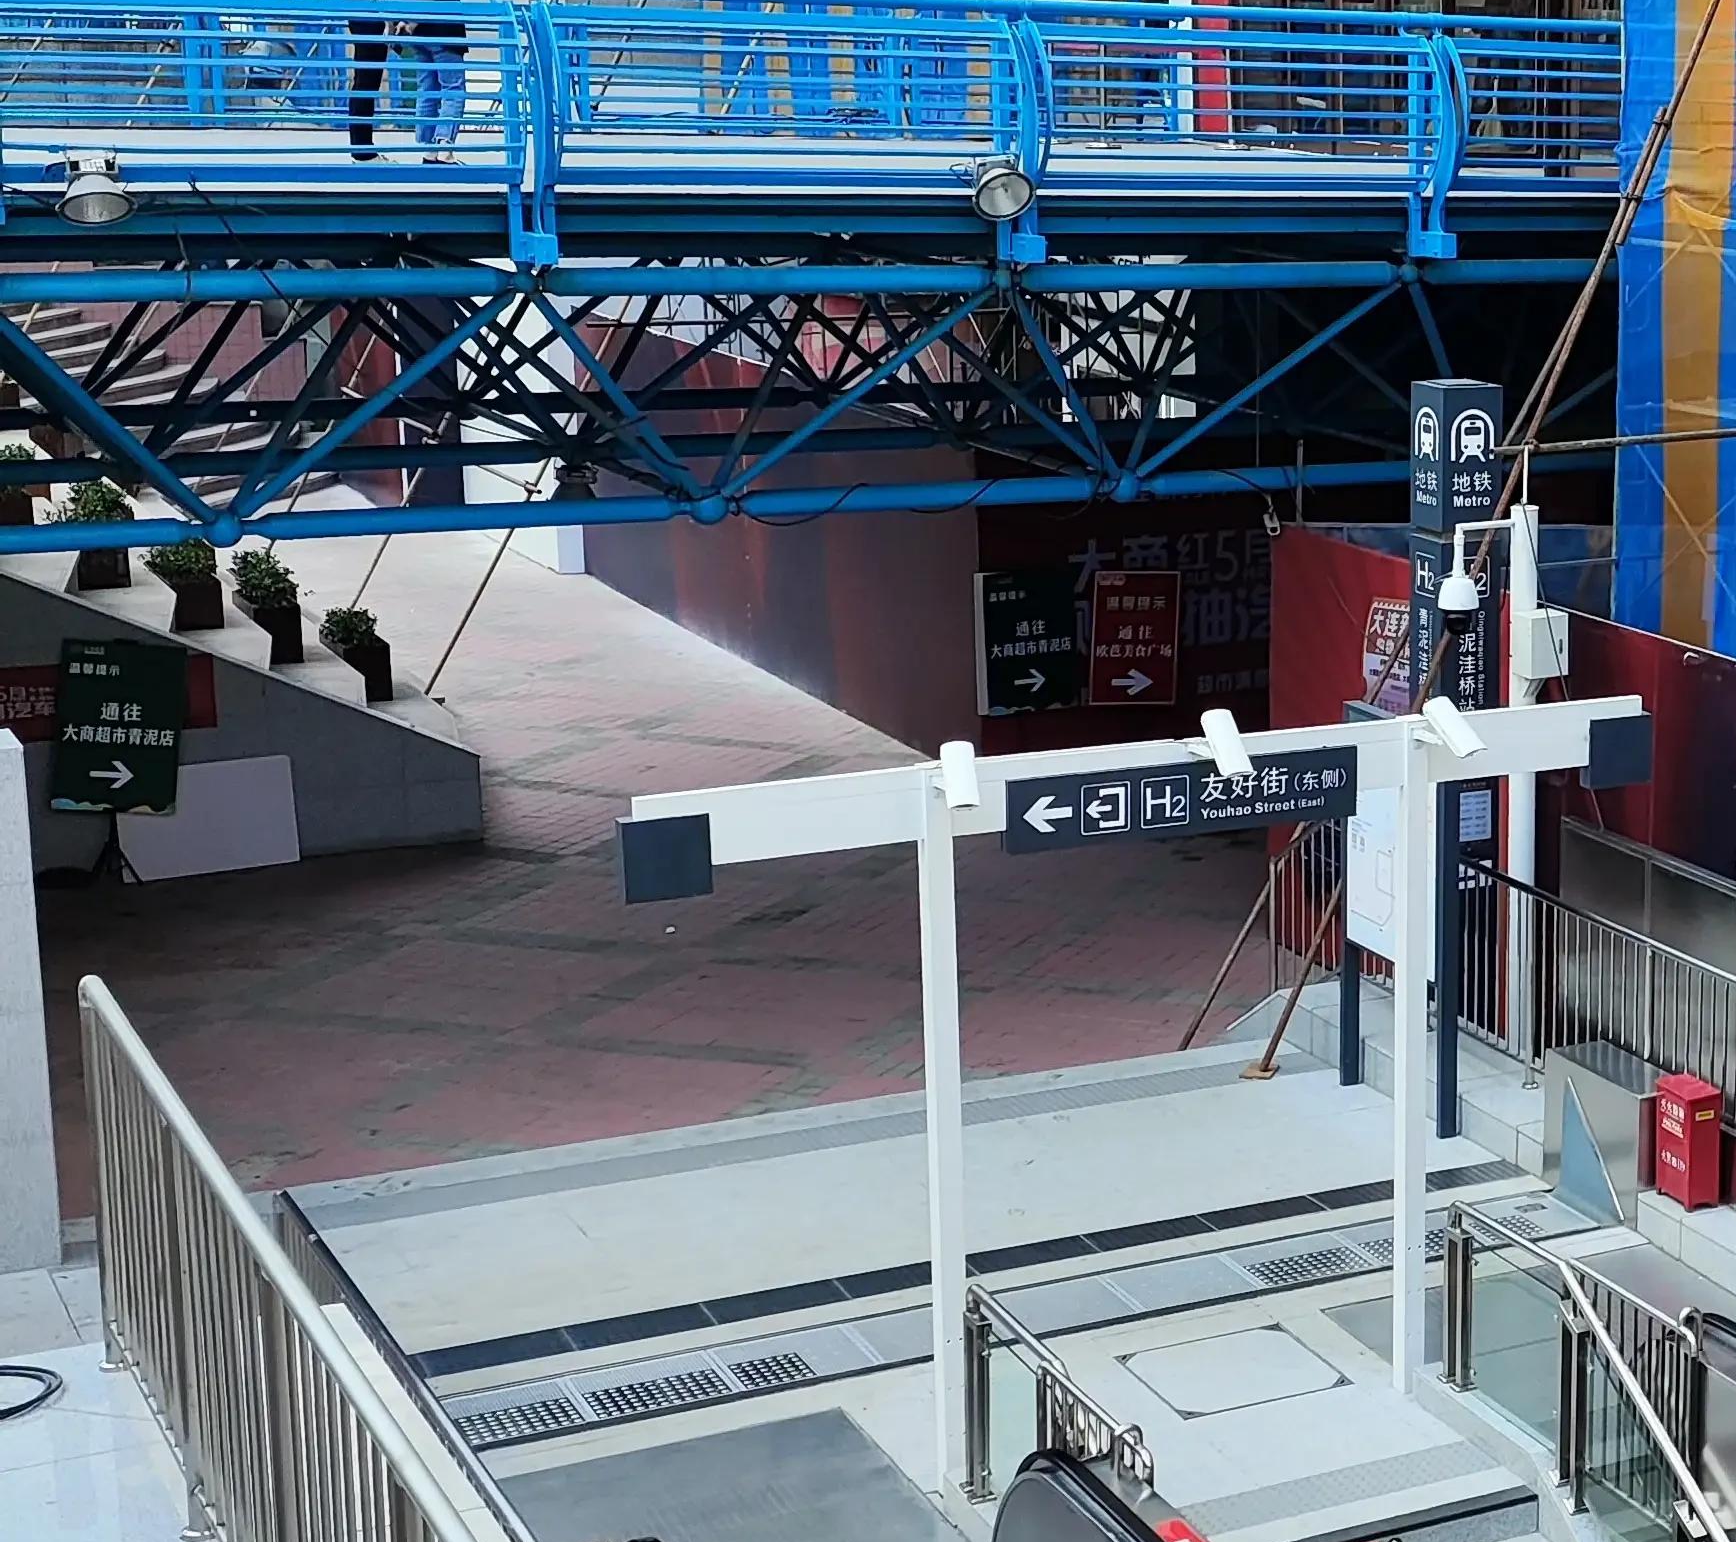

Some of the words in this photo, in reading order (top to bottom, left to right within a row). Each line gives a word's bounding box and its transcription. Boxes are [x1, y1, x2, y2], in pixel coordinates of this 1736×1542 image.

[1415, 468, 1437, 491] 地铁
[1452, 471, 1492, 492] 地铁
[1416, 490, 1436, 506] Metro
[1453, 495, 1490, 507] Metro
[1418, 560, 1434, 590] H2
[1015, 619, 1046, 638] 通往
[1458, 619, 1476, 711] 泥洼桥站
[100, 702, 142, 722] 通往
[62, 724, 174, 747] 大商超市青泥店
[1145, 785, 1186, 820] H2
[1201, 804, 1252, 821] Youhao
[1255, 800, 1296, 815] Street
[1298, 795, 1325, 809] (East)
